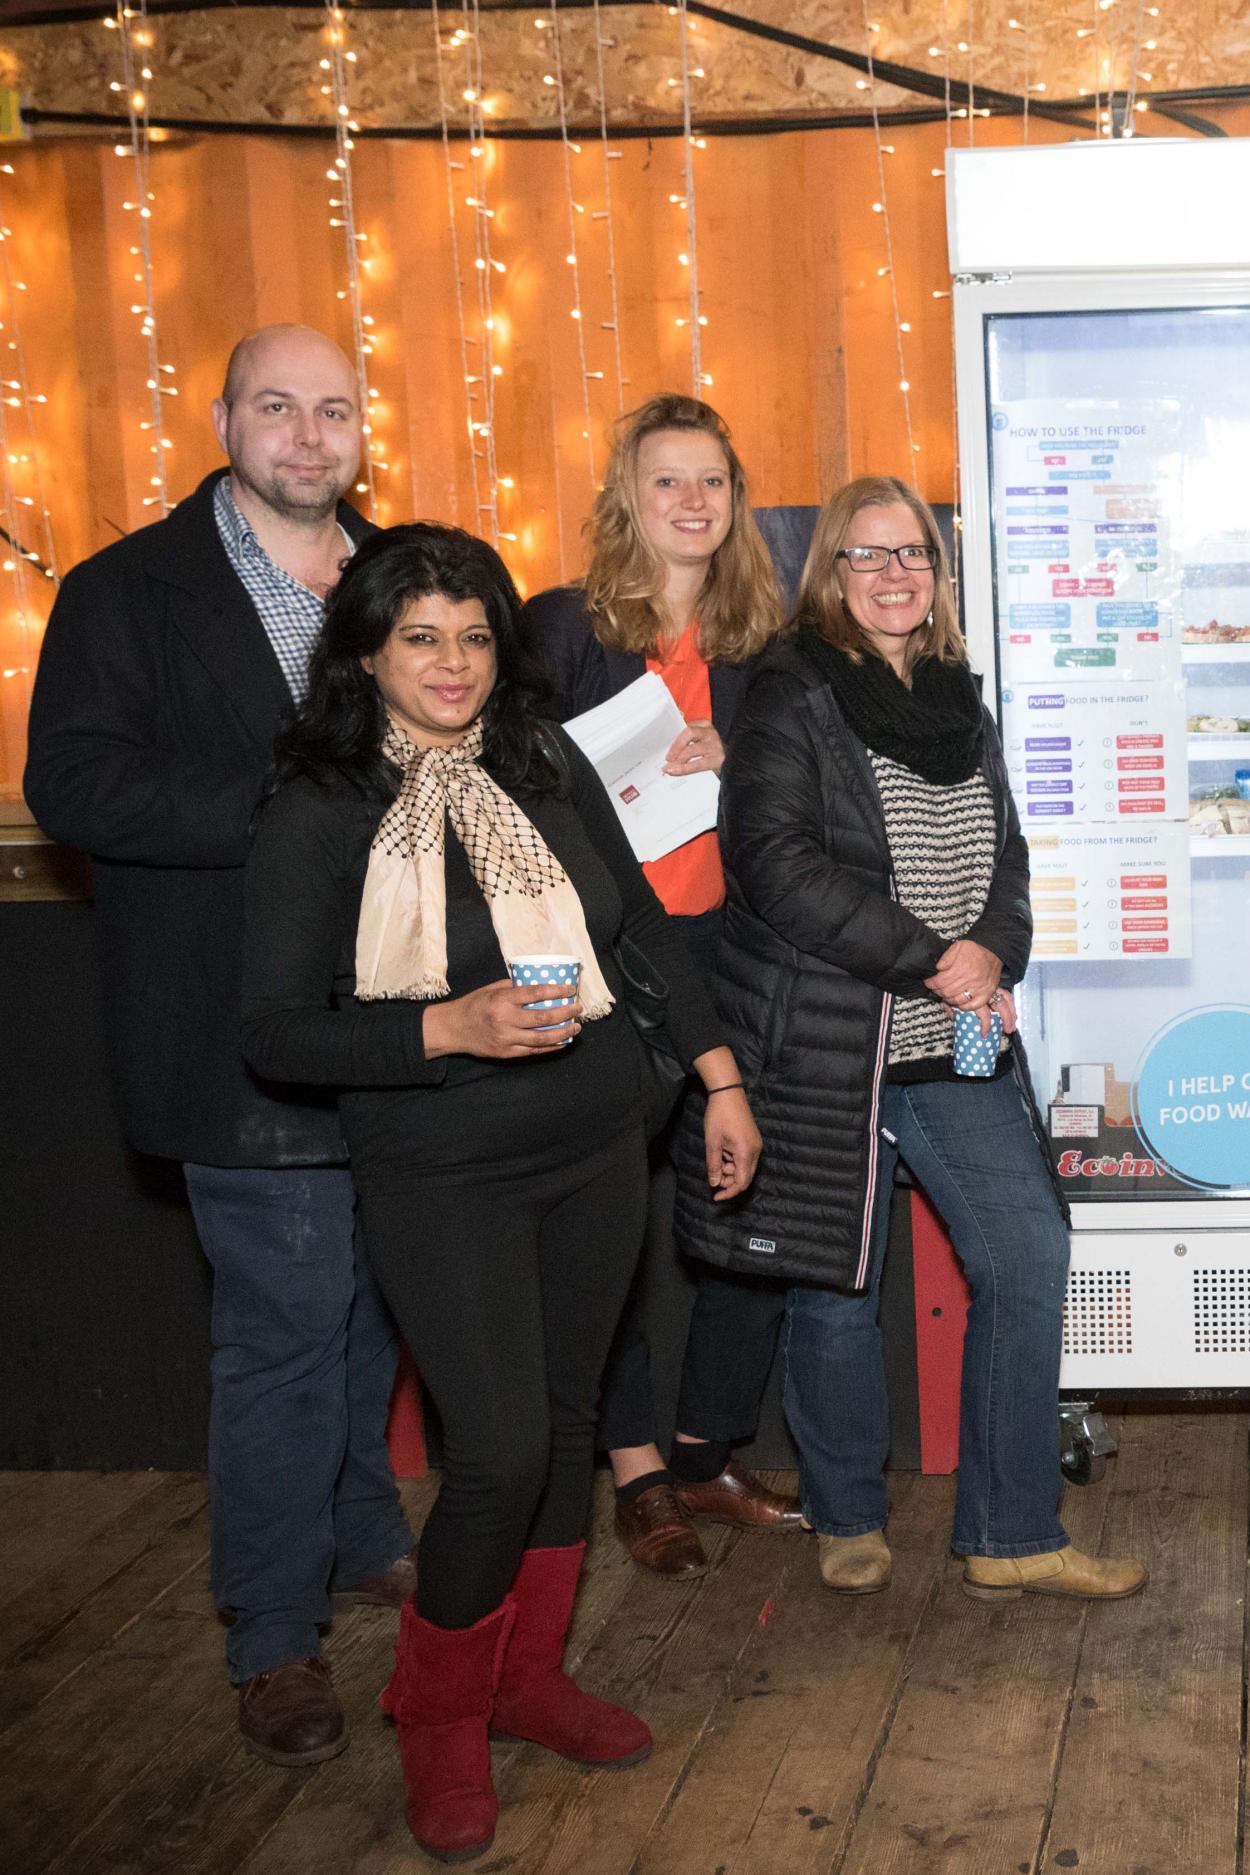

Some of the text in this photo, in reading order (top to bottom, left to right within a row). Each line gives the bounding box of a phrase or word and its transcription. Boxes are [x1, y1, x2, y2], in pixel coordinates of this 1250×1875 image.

[1009, 426, 1038, 438] HOW
[1042, 426, 1056, 437] TO
[1059, 426, 1080, 437] USE
[1028, 696, 1064, 706] PUTTING
[1089, 696, 1098, 704] IN
[1101, 695, 1114, 703] THE
[1116, 694, 1150, 703] FRIDGE?
[1060, 838, 1082, 846] FOOD
[1109, 837, 1123, 845] THE
[1125, 836, 1158, 844] FRIDGE?
[1168, 1079, 1174, 1097] I
[1180, 1073, 1236, 1096] HELP
[1158, 1103, 1221, 1126] FOOD
[751, 1239, 774, 1251] PUFFA
